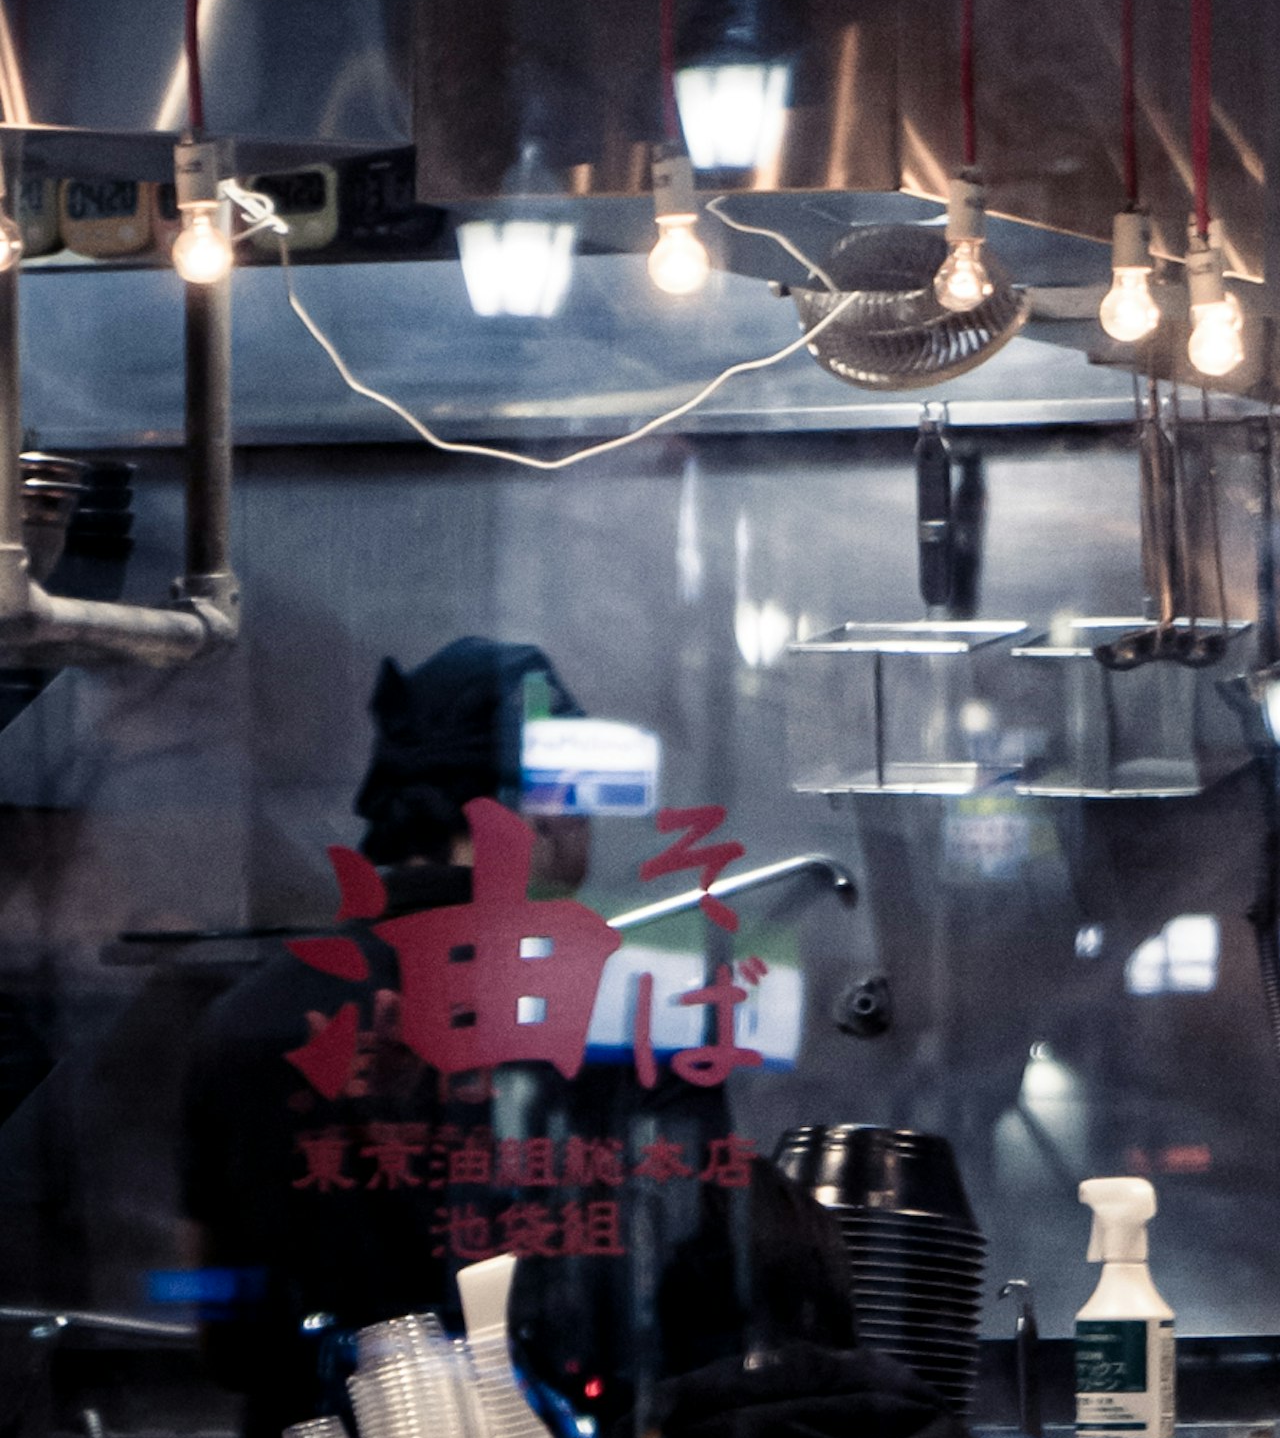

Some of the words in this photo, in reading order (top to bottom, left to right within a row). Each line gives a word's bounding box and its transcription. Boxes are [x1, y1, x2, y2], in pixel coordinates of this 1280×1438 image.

[289, 1130, 758, 1191] 東京油組総本店
[430, 1201, 626, 1260] 池袋組
